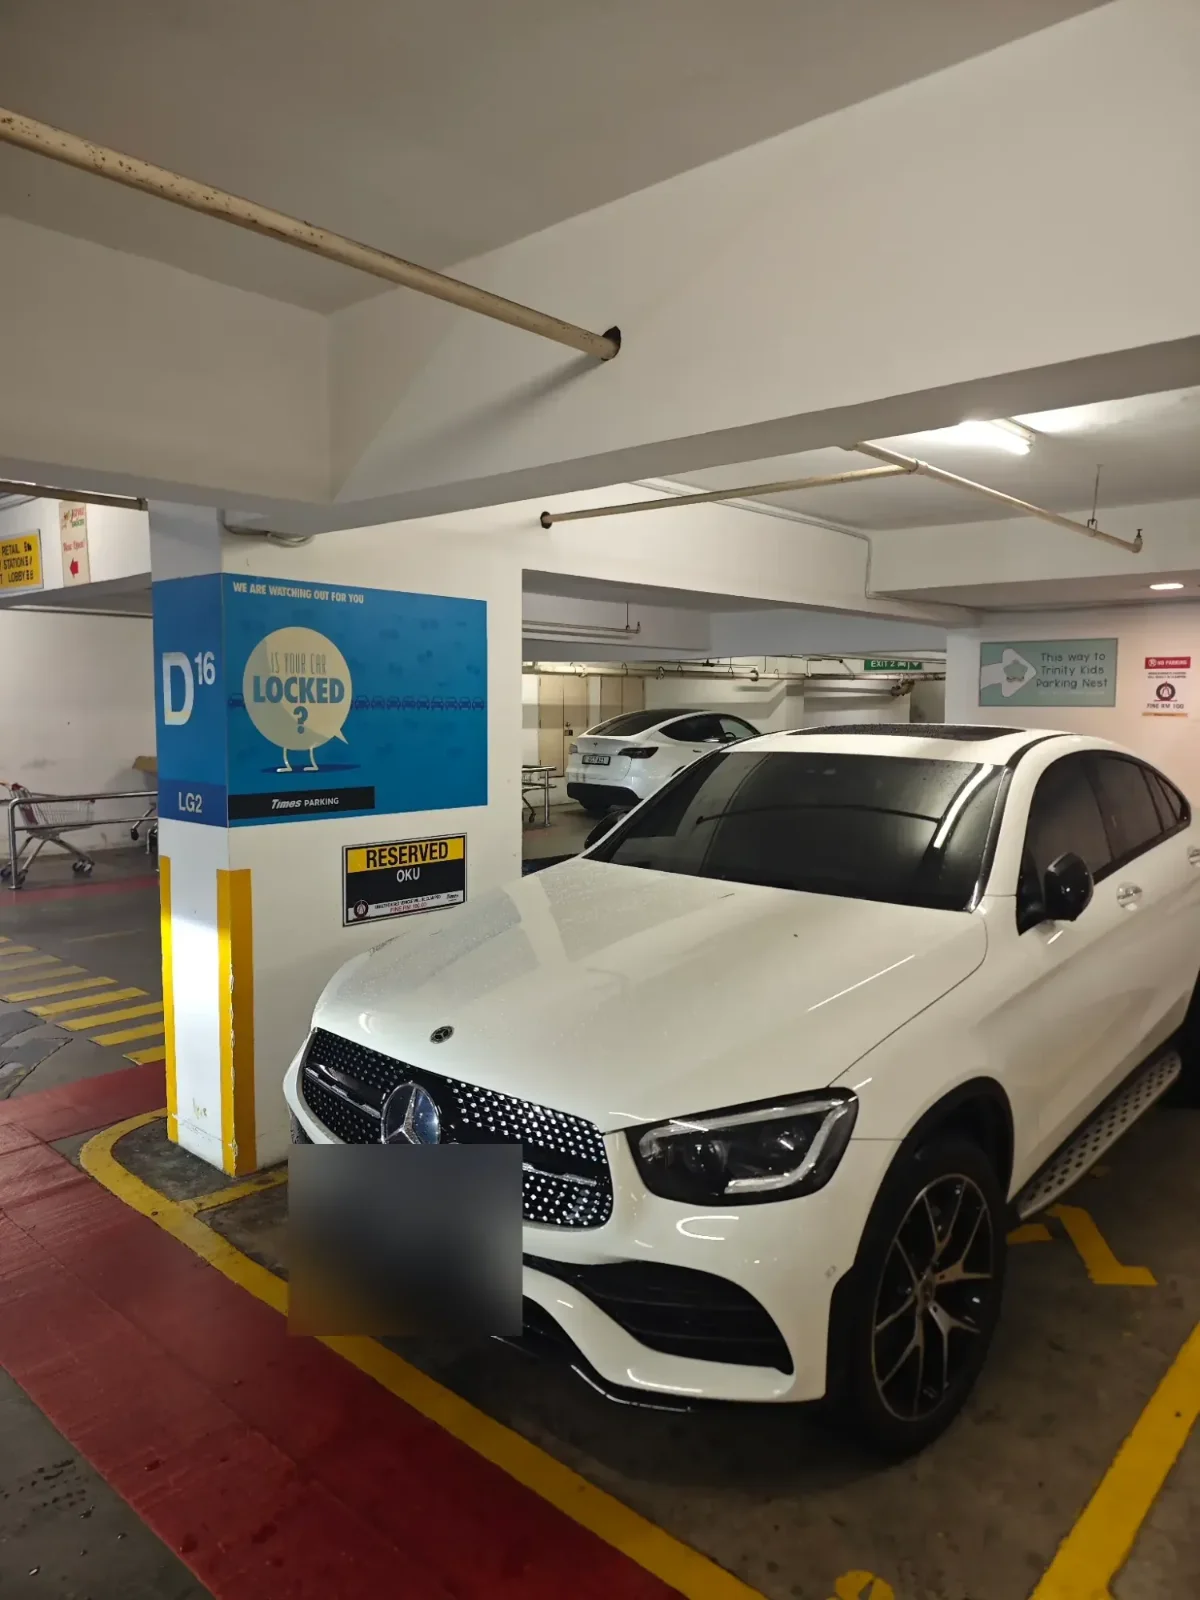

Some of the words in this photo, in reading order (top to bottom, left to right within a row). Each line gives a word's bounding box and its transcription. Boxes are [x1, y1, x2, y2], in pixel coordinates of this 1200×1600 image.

[2, 544, 20, 556] RETAIL
[3, 556, 25, 570] STATION
[8, 571, 25, 583] LOBBY
[232, 581, 248, 593] WE
[249, 583, 267, 595] ARE
[268, 586, 312, 599] WATCHING
[313, 590, 329, 600] OUT
[331, 592, 347, 602] FOR
[348, 593, 364, 604] YOU
[270, 652, 280, 674] IS
[284, 652, 306, 675] YOUR
[310, 653, 327, 675] CAR
[870, 660, 888, 668] EXIT
[1040, 652, 1063, 662] This
[1068, 653, 1091, 663] way
[1094, 652, 1106, 661] to
[1041, 665, 1076, 676] Trinity
[1080, 665, 1105, 675] Kids
[252, 676, 345, 704] LOCKED
[1036, 678, 1078, 690] Parking
[1082, 678, 1108, 688] Nest
[293, 706, 308, 734] ?
[178, 791, 203, 814] LG2
[271, 799, 302, 809] Times
[304, 797, 339, 807] PARKING
[366, 841, 449, 869] RESERVED
[396, 866, 421, 883] OKU
